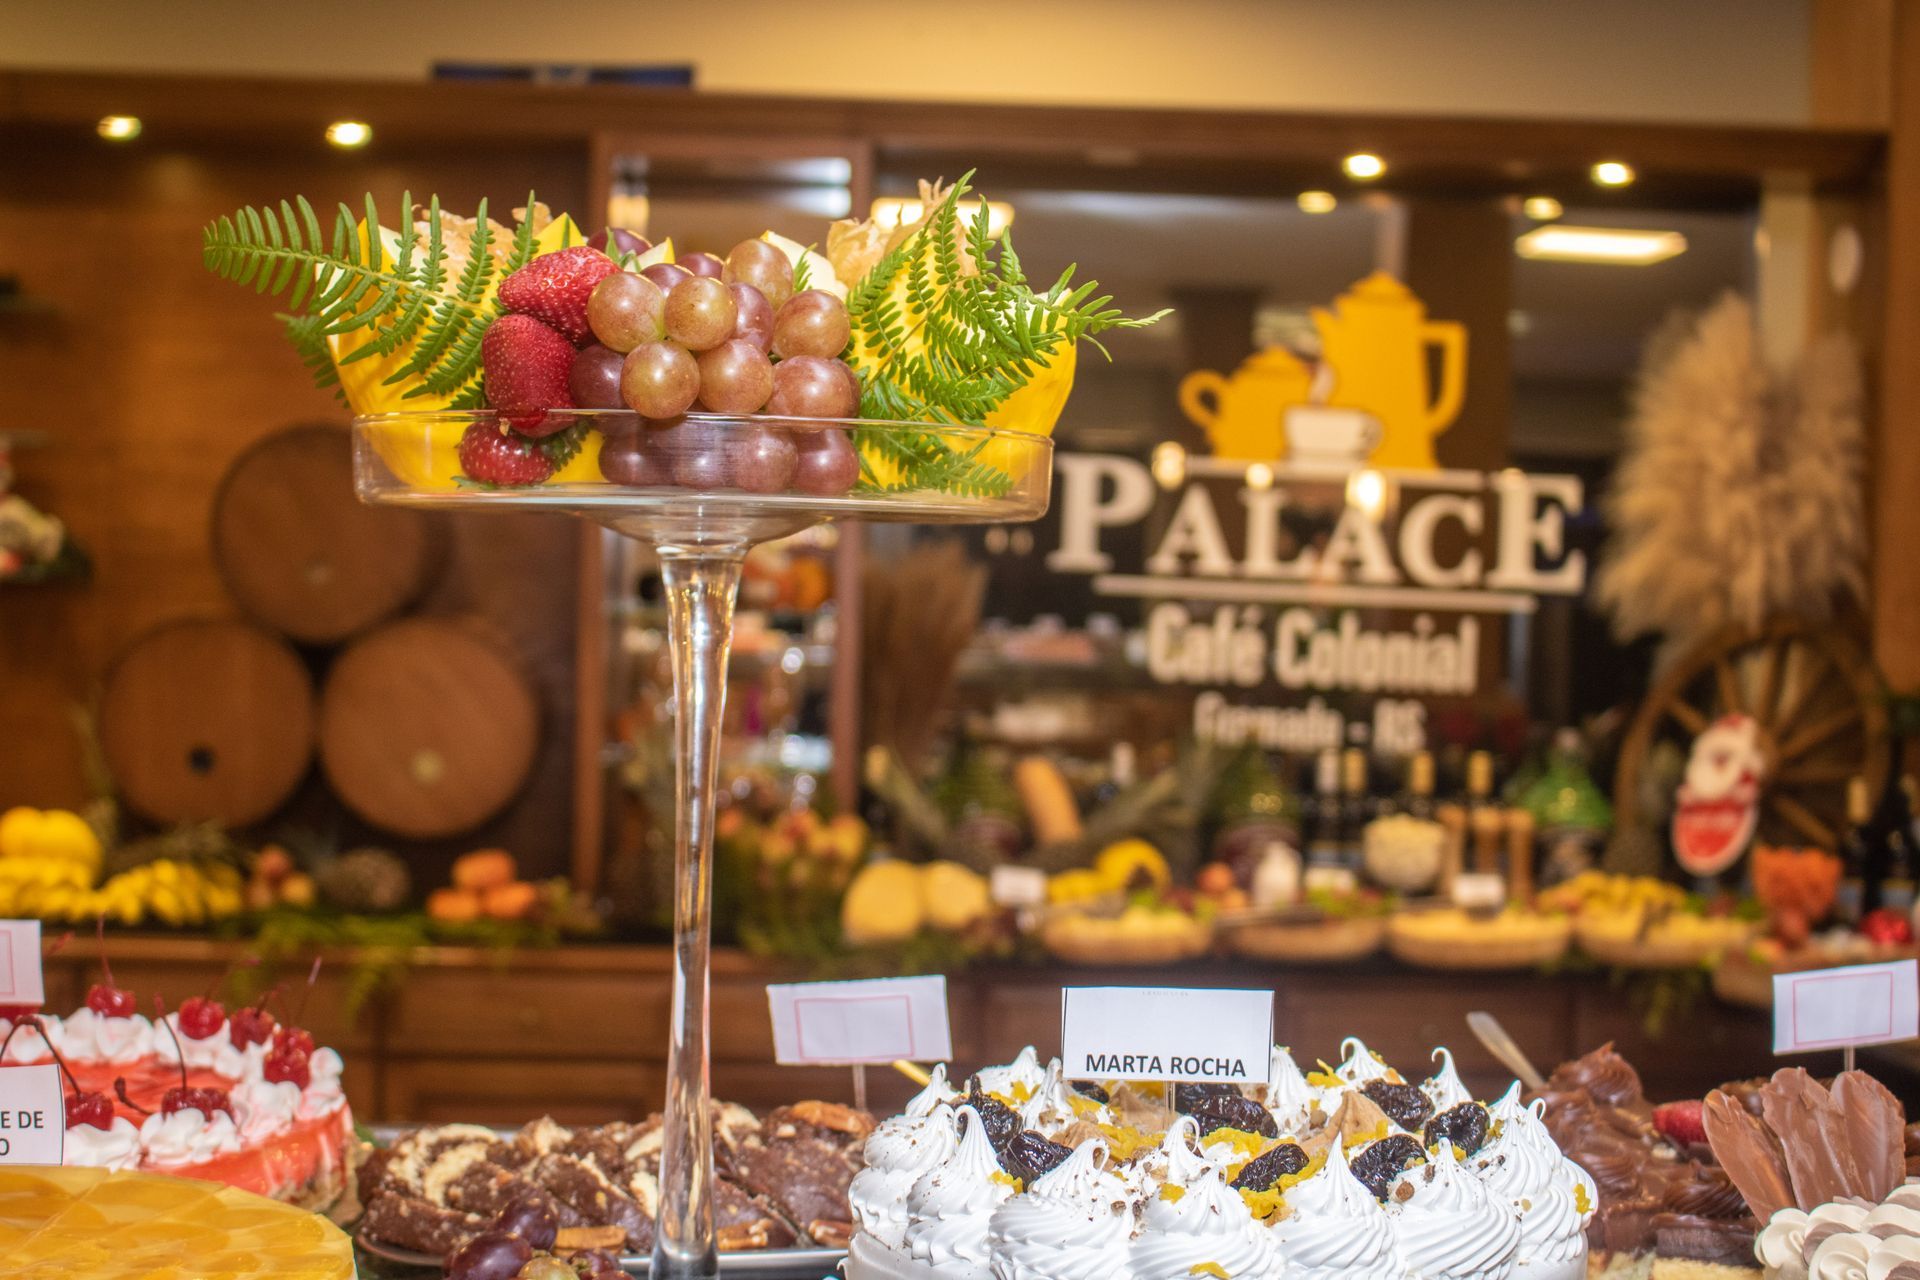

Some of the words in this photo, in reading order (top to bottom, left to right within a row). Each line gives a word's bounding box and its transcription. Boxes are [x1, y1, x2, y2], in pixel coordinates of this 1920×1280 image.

[1047, 452, 1587, 595] PALACE
[1147, 603, 1267, 687] Café
[1275, 606, 1480, 695] Colonial
[1086, 1053, 1163, 1074] MARTA
[1170, 1056, 1247, 1077] ROCHA
[18, 1110, 44, 1129] DE
